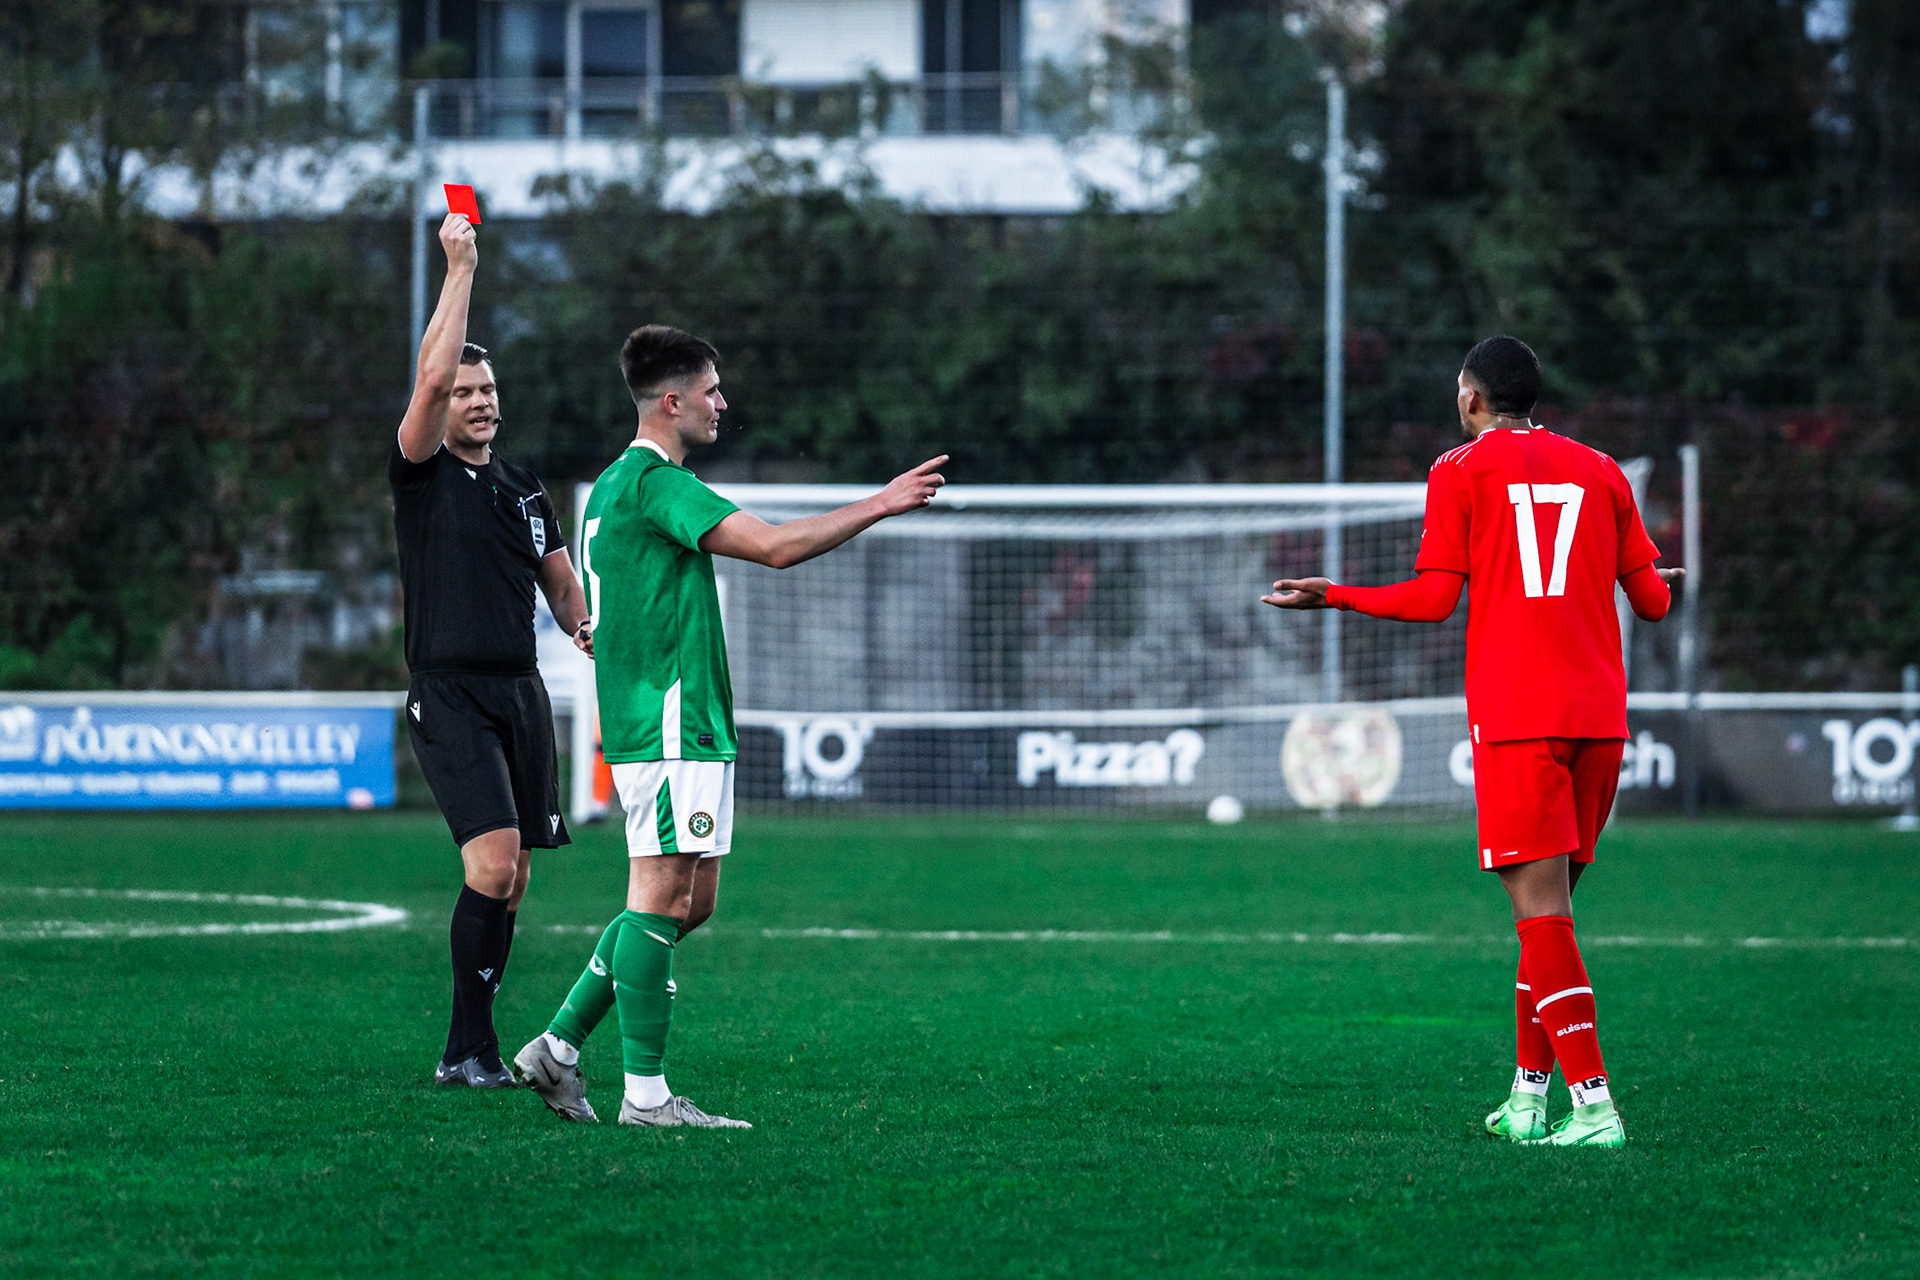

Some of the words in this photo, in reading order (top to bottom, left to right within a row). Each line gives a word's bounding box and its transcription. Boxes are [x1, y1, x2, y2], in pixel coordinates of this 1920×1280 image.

[1507, 483, 1585, 598] 17
[1017, 729, 1205, 787] Pizza?
[1556, 1022, 1593, 1037] suisse
